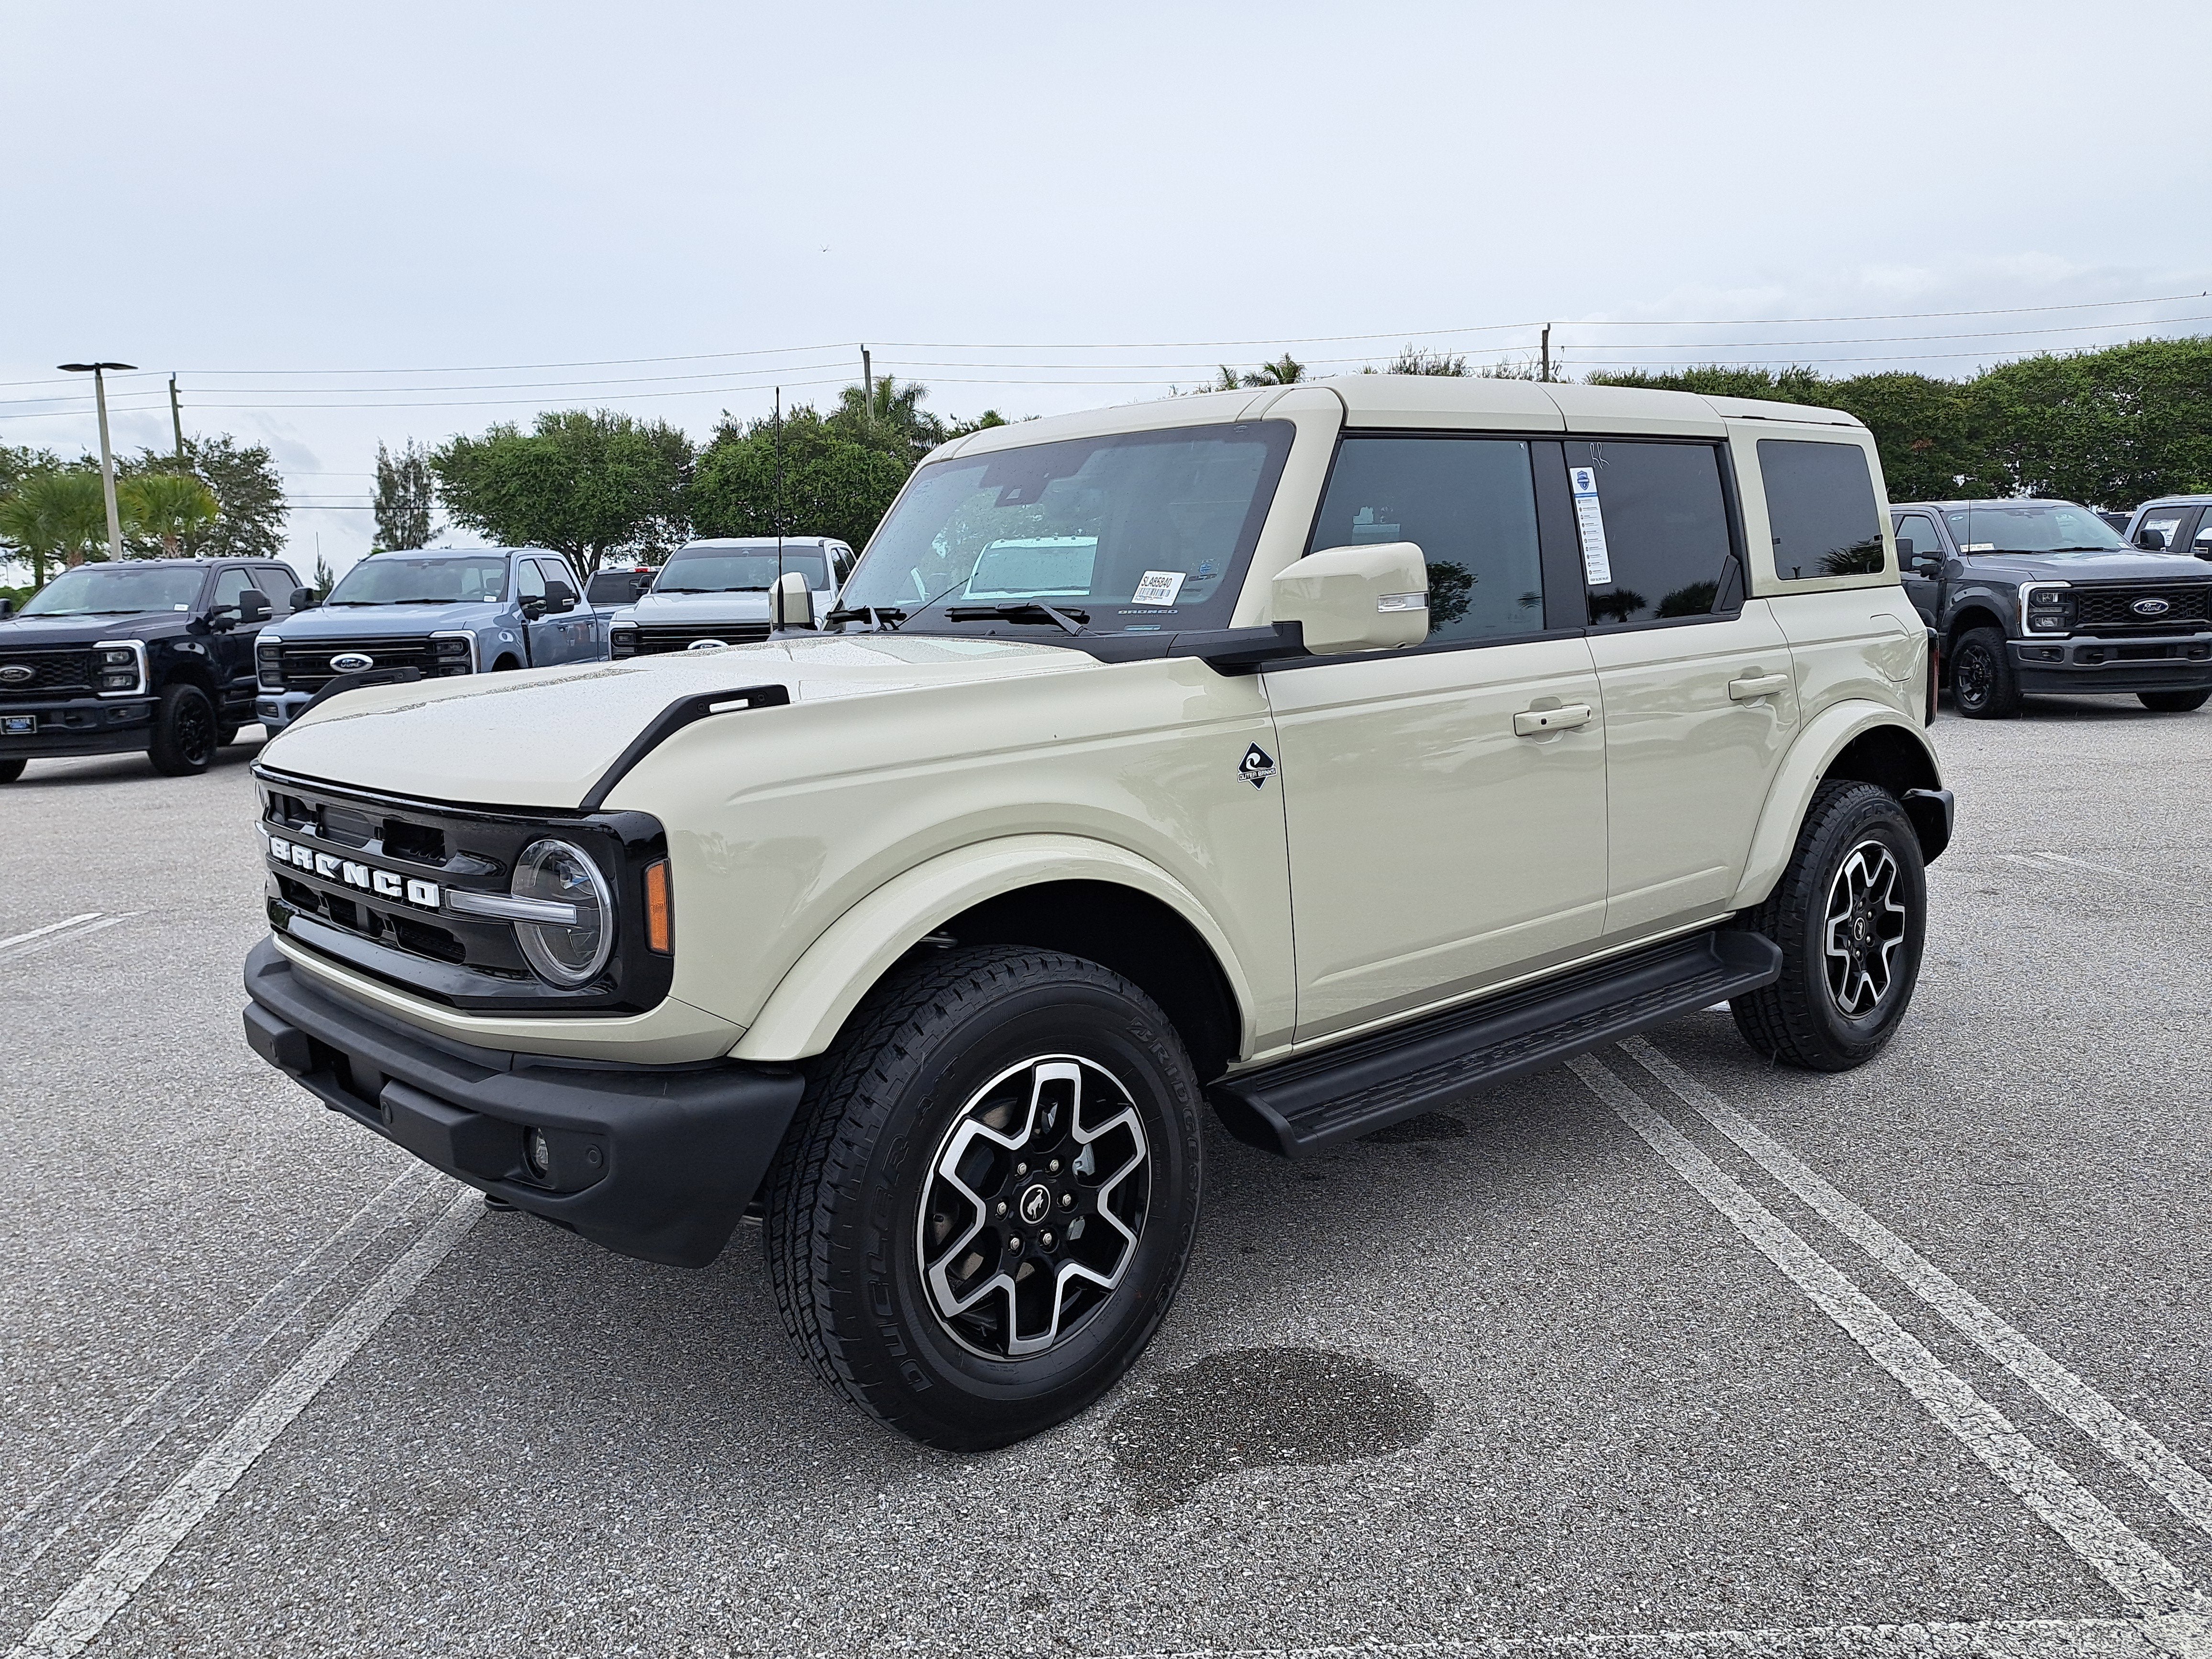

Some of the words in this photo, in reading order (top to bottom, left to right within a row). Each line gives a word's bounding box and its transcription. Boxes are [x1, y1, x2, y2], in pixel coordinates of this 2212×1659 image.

[1141, 576, 1172, 588] SLA85840
[2142, 603, 2162, 611] Ford
[1239, 772, 1257, 780] OUTER
